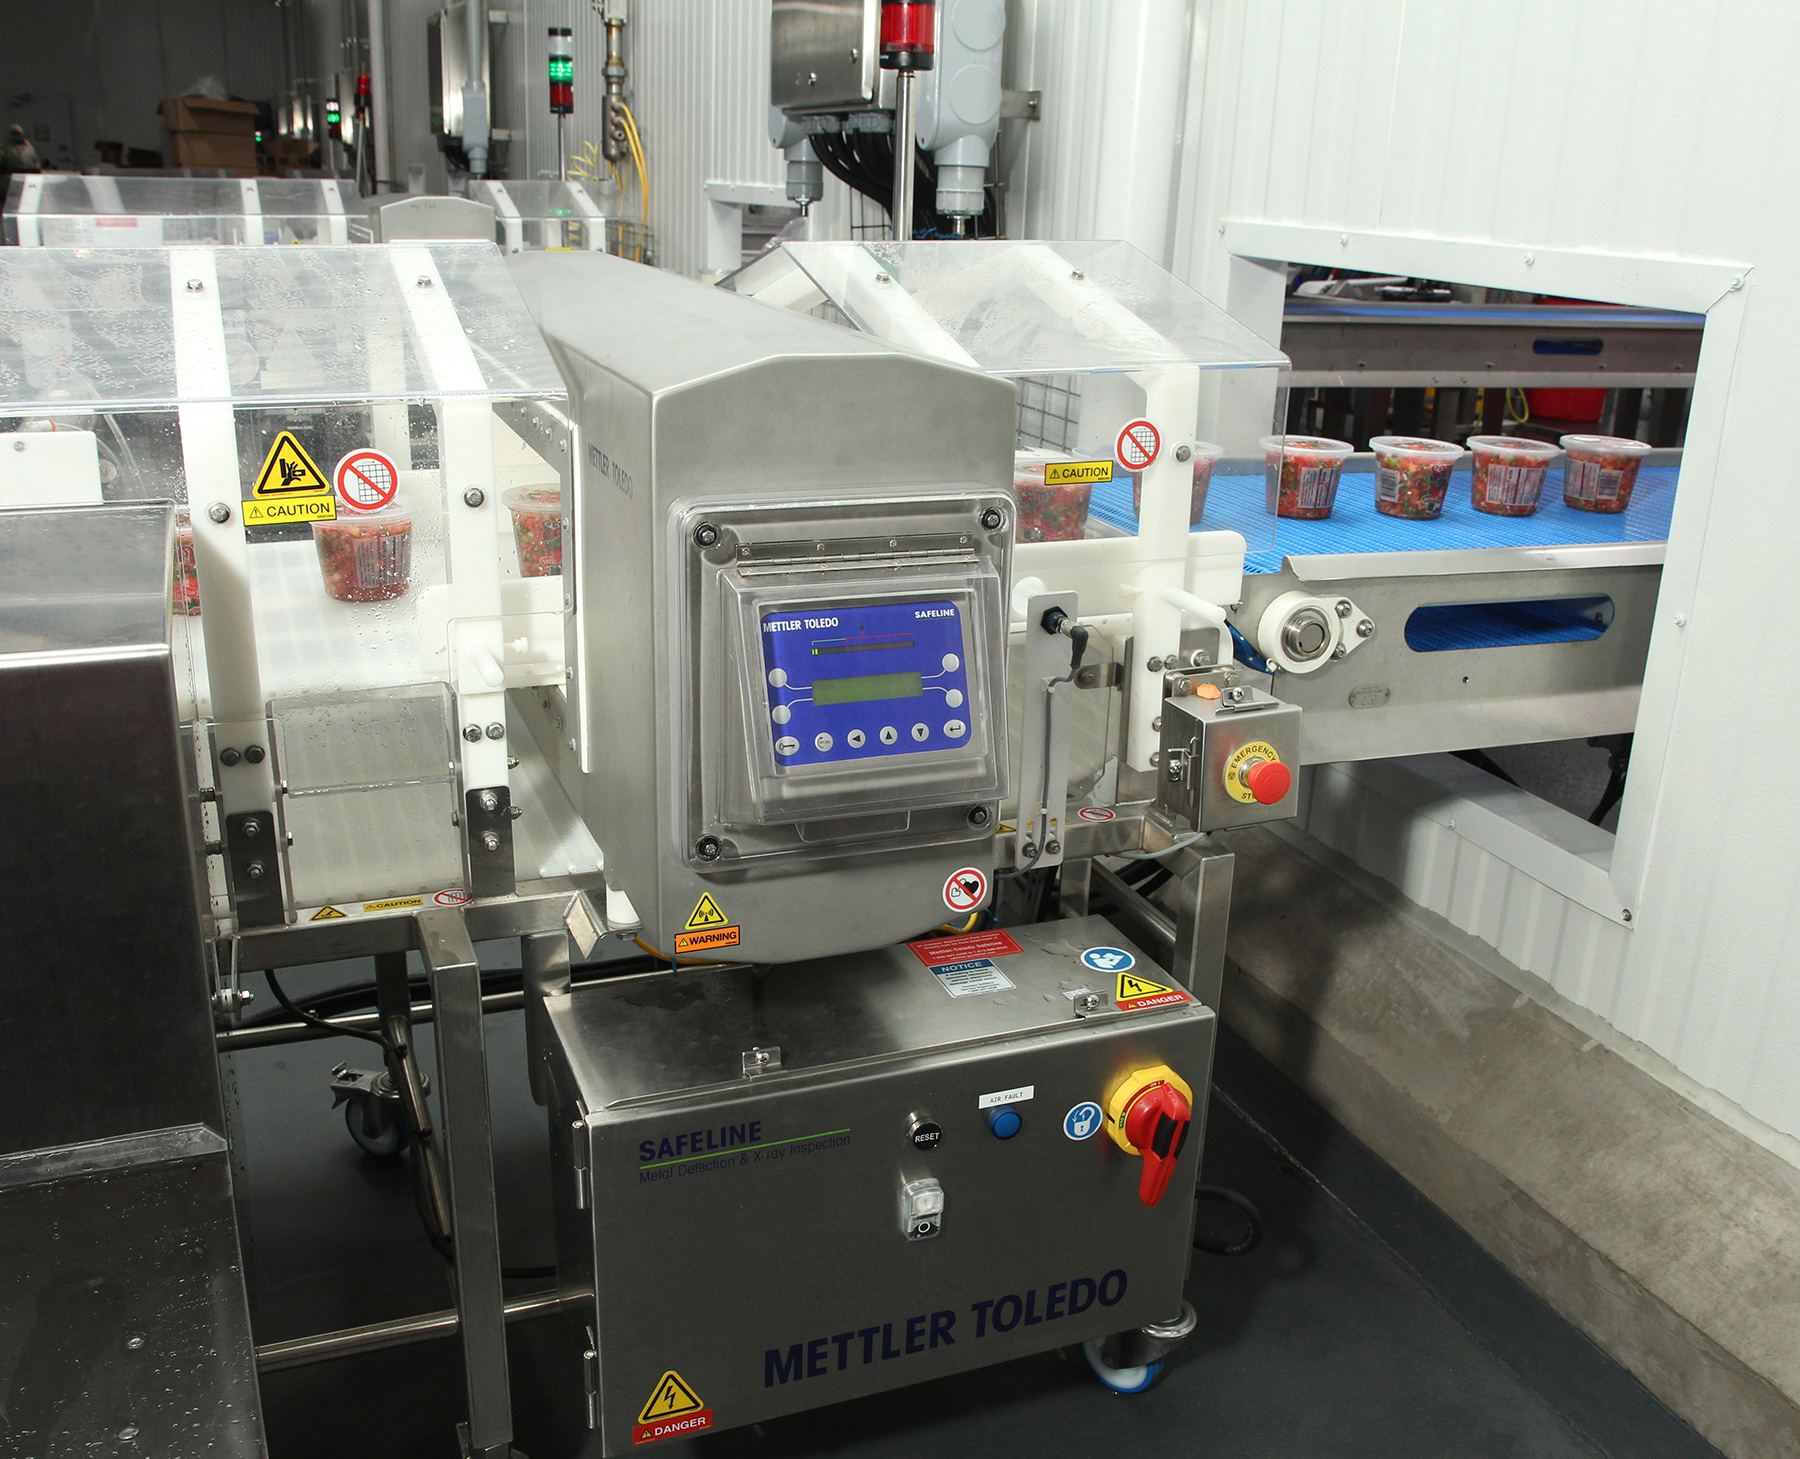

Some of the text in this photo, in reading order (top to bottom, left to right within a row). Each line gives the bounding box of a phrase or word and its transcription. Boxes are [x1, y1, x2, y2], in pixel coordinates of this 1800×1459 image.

[588, 442, 633, 499] METTLER TOLEDO
[1062, 467, 1109, 479] CAUTION
[267, 503, 330, 517] CAUTION
[914, 608, 955, 619] SAFELINE
[763, 617, 839, 633] METTLER TOLEDO
[1231, 746, 1276, 768] EMERGENCY
[376, 899, 421, 909] CAUTION
[689, 931, 737, 945] WARNING
[941, 961, 983, 972] NOTICE
[1136, 994, 1184, 1007] DANGER
[1004, 1092, 1024, 1100] FAULT
[639, 1120, 762, 1162] SAFELINE
[915, 1132, 940, 1143] RESET
[639, 1135, 851, 1184] Metal Detection & X-ray Inspection
[764, 1268, 1128, 1388] METTLER TOLEDO
[654, 1416, 706, 1436] DANGER
